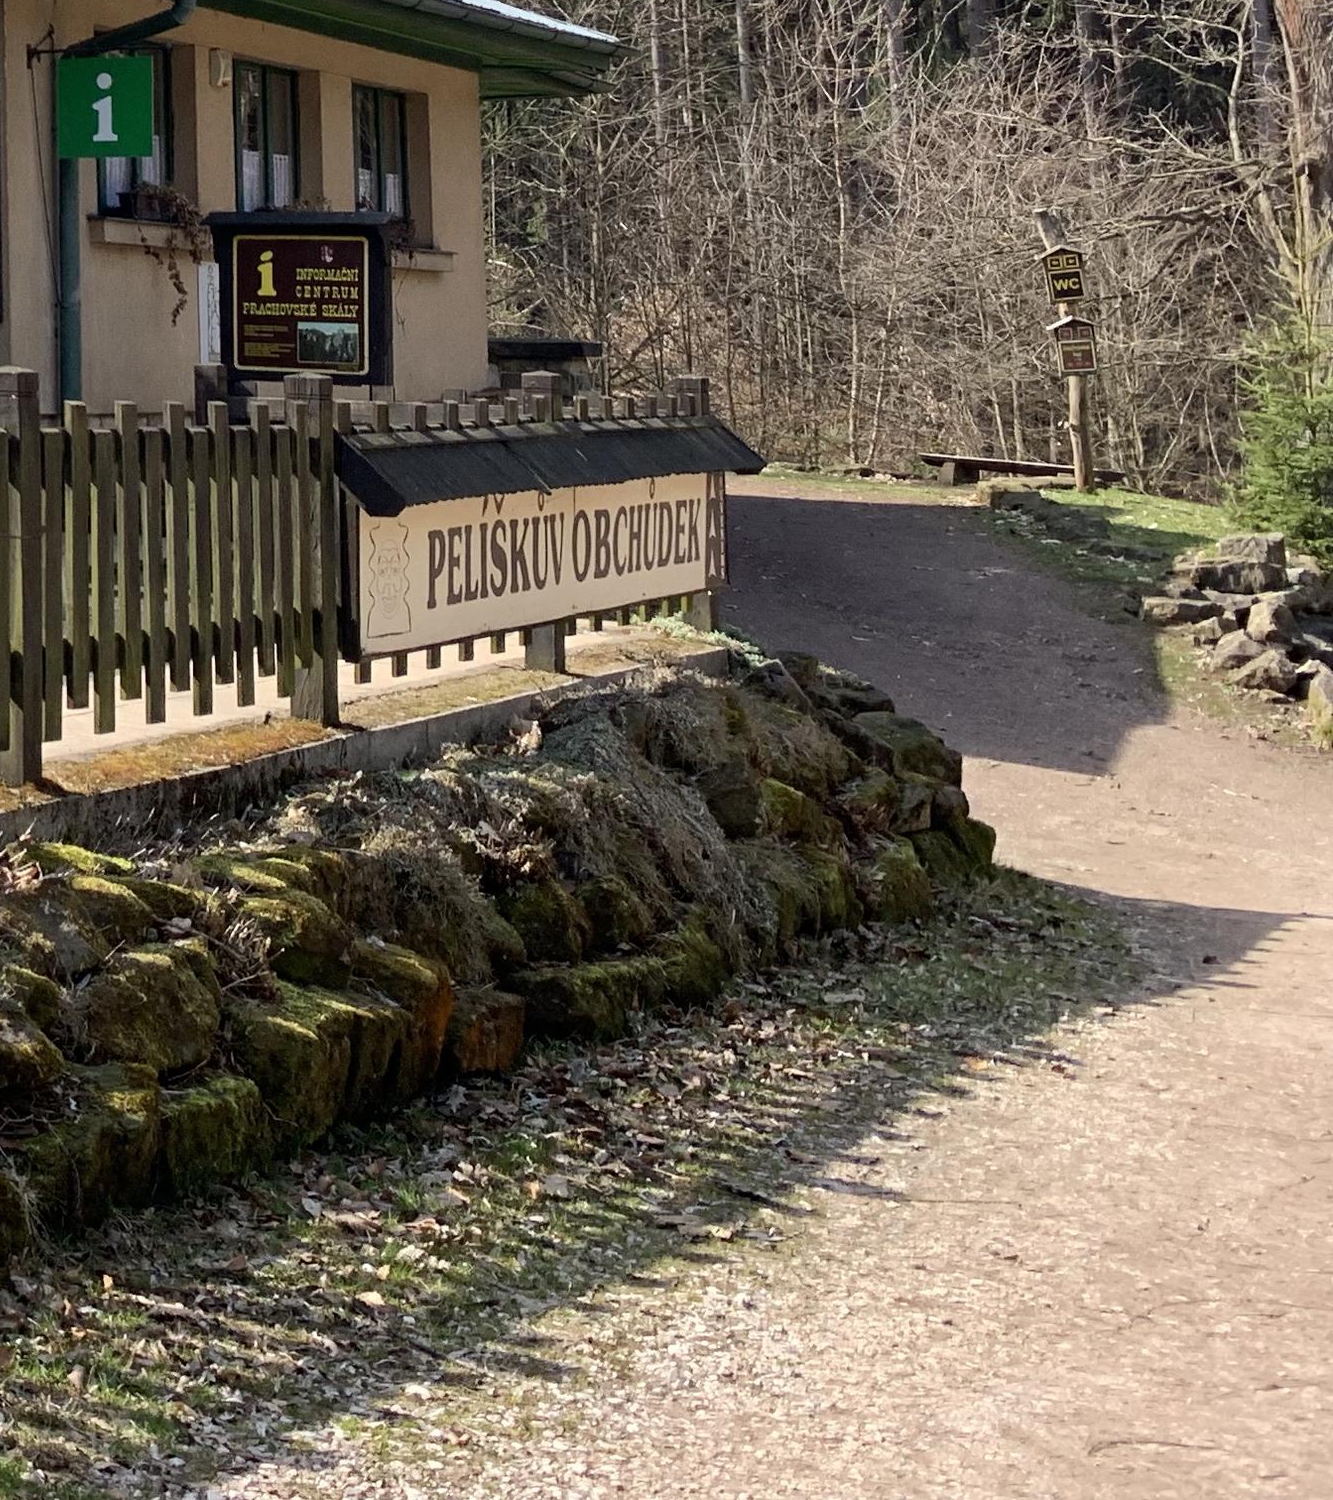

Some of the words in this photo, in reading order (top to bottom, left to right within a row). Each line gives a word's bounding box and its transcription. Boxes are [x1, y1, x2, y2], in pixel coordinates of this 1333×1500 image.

[1053, 277, 1081, 291] WC
[295, 285, 359, 299] CENTRUM
[242, 301, 317, 317] PRACHOVSKÉ
[322, 302, 359, 318] SKÁLY
[572, 476, 702, 583] OBCHŮDEK
